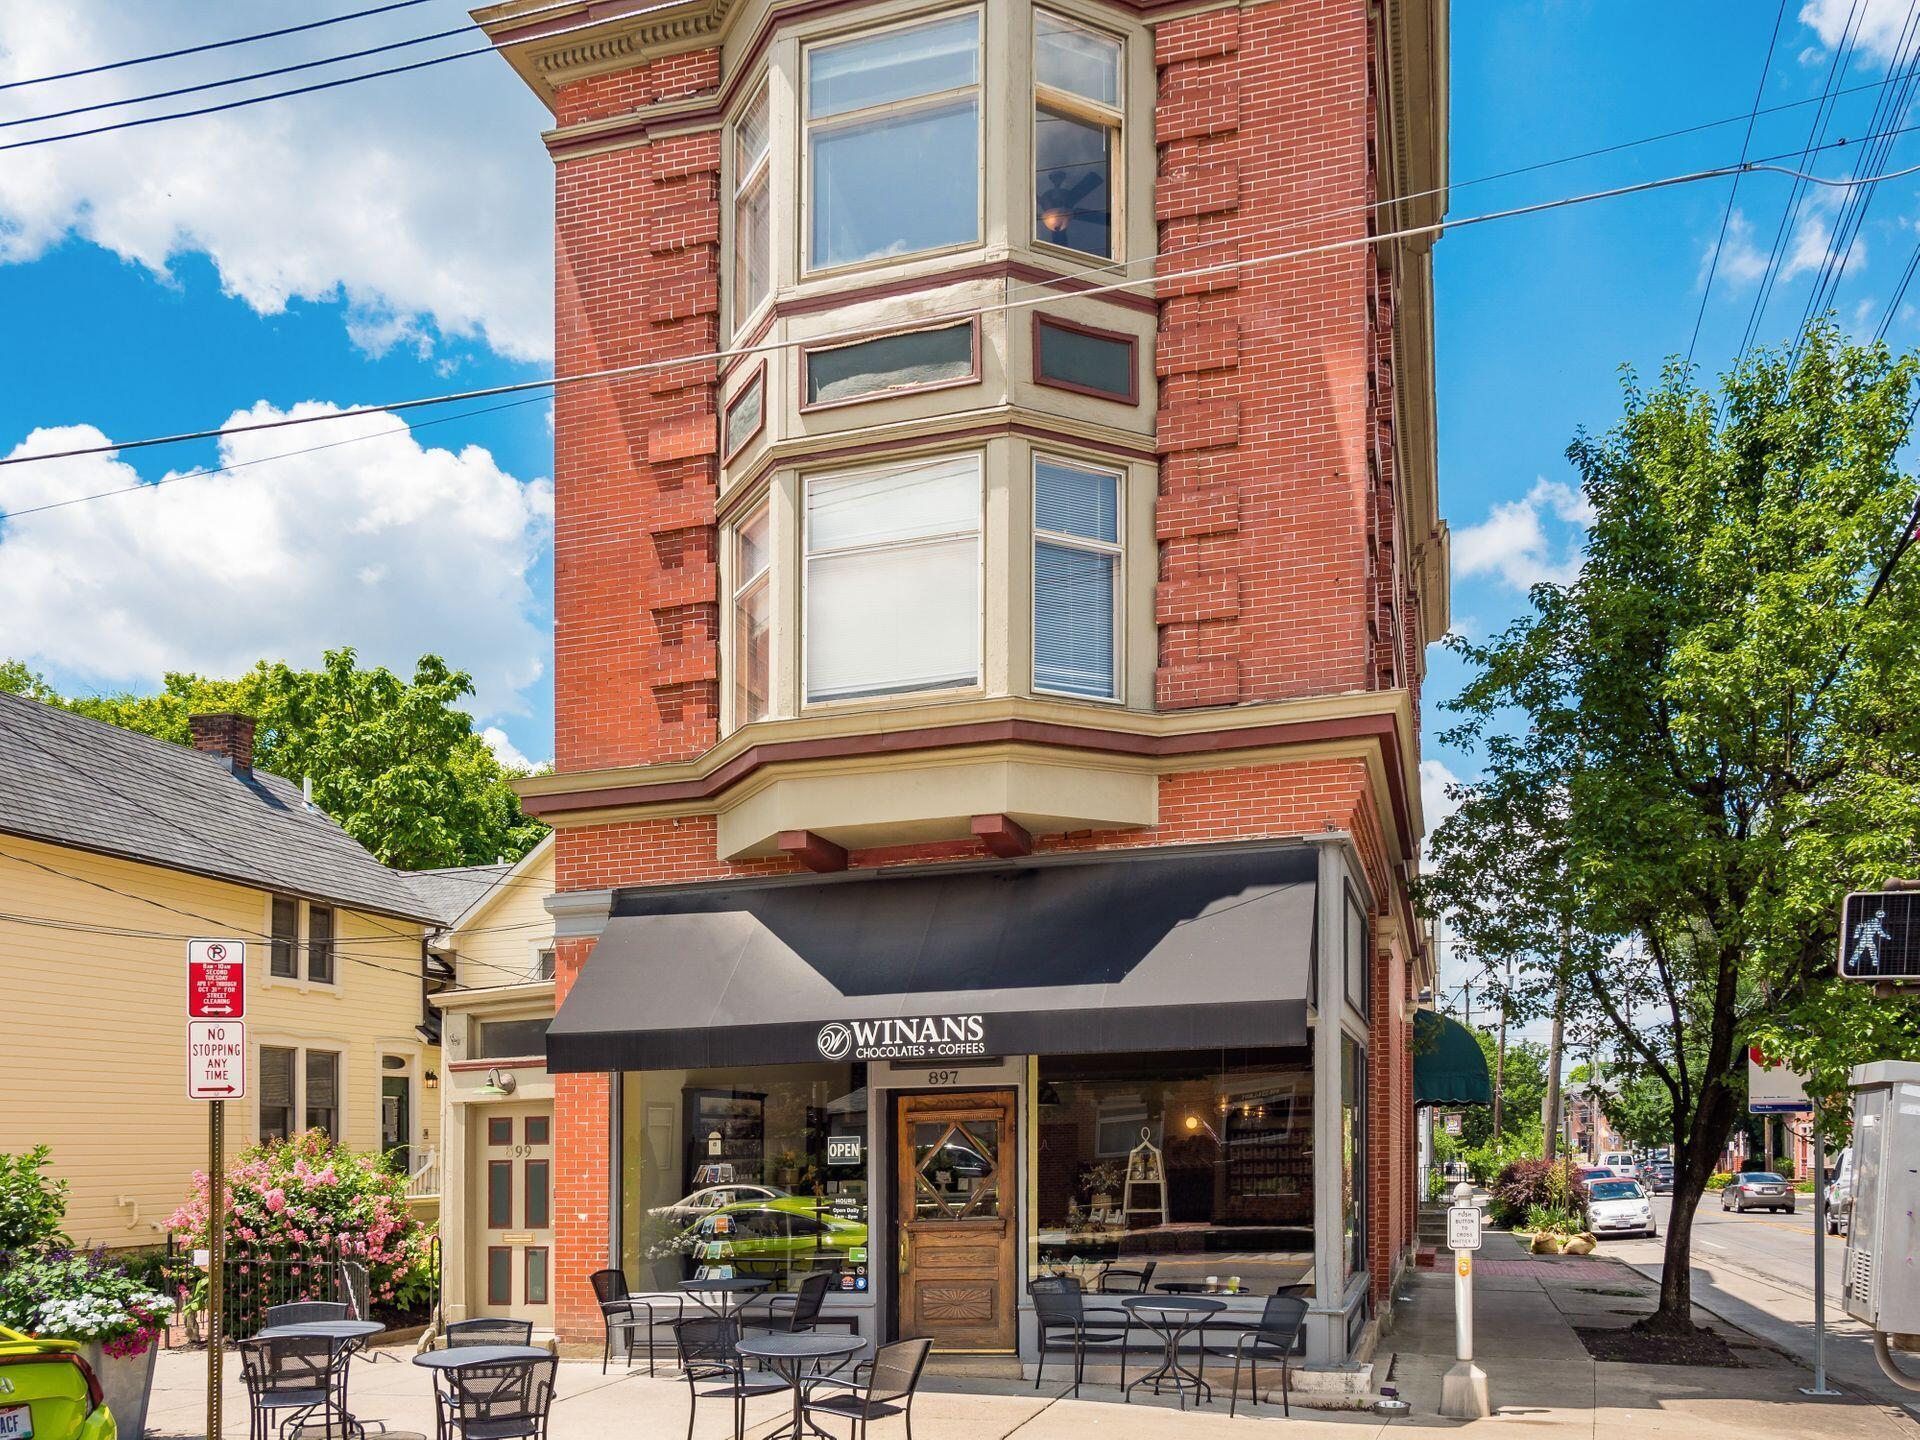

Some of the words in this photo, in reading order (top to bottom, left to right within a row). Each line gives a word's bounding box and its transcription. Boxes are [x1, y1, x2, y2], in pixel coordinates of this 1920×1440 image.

[208, 1028, 225, 1040] NO
[850, 1015, 984, 1046] WINANS
[192, 1044, 240, 1056] STOPPING
[856, 1046, 924, 1059] CHOCOLATES
[938, 1043, 985, 1056] COFFEES
[208, 1059, 228, 1068] ANY
[205, 1070, 228, 1080] TIME
[928, 1071, 959, 1085] 897
[829, 1144, 859, 1157] OPEN
